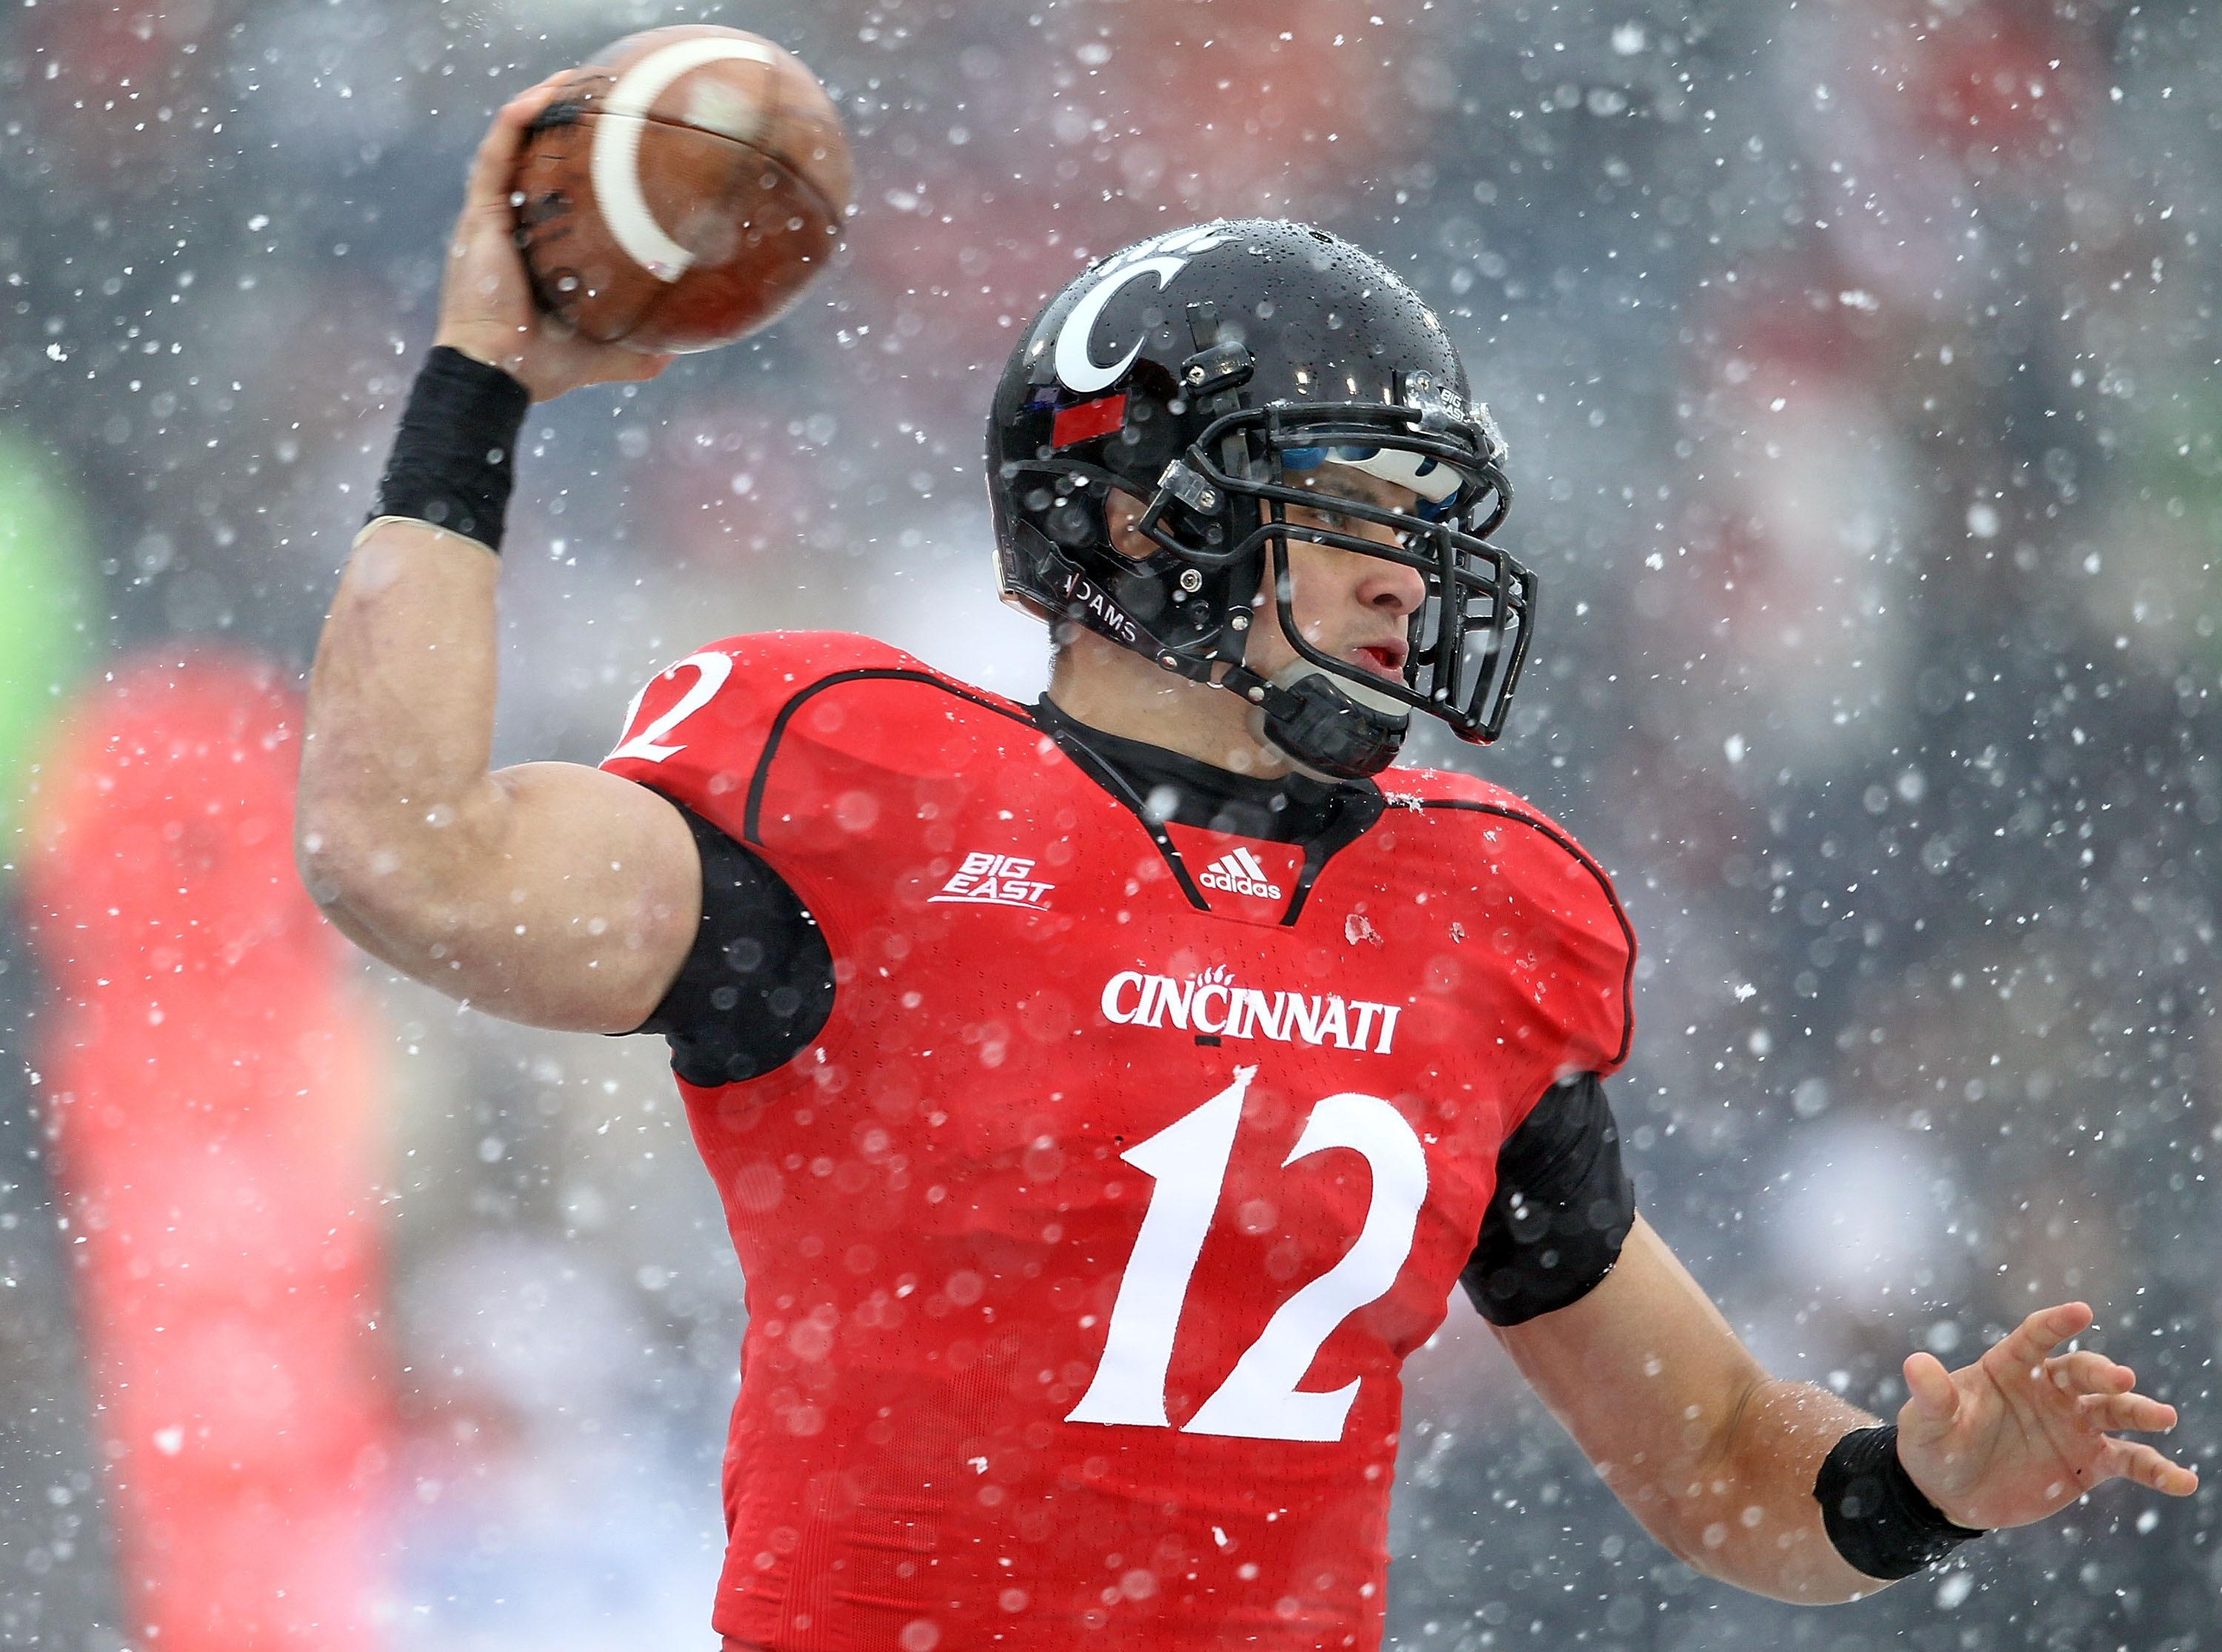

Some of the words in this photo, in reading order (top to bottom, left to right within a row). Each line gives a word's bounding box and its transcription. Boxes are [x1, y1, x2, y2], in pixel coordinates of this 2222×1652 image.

[1055, 256, 1187, 392] C
[1441, 389, 1462, 408] BIG
[1442, 401, 1466, 422] AST
[958, 852, 1036, 880] BIG
[941, 873, 1056, 903] EAST
[1198, 872, 1281, 900] adidas
[1101, 966, 1402, 1054] CINCINNATI
[1064, 1072, 1429, 1442] 12
